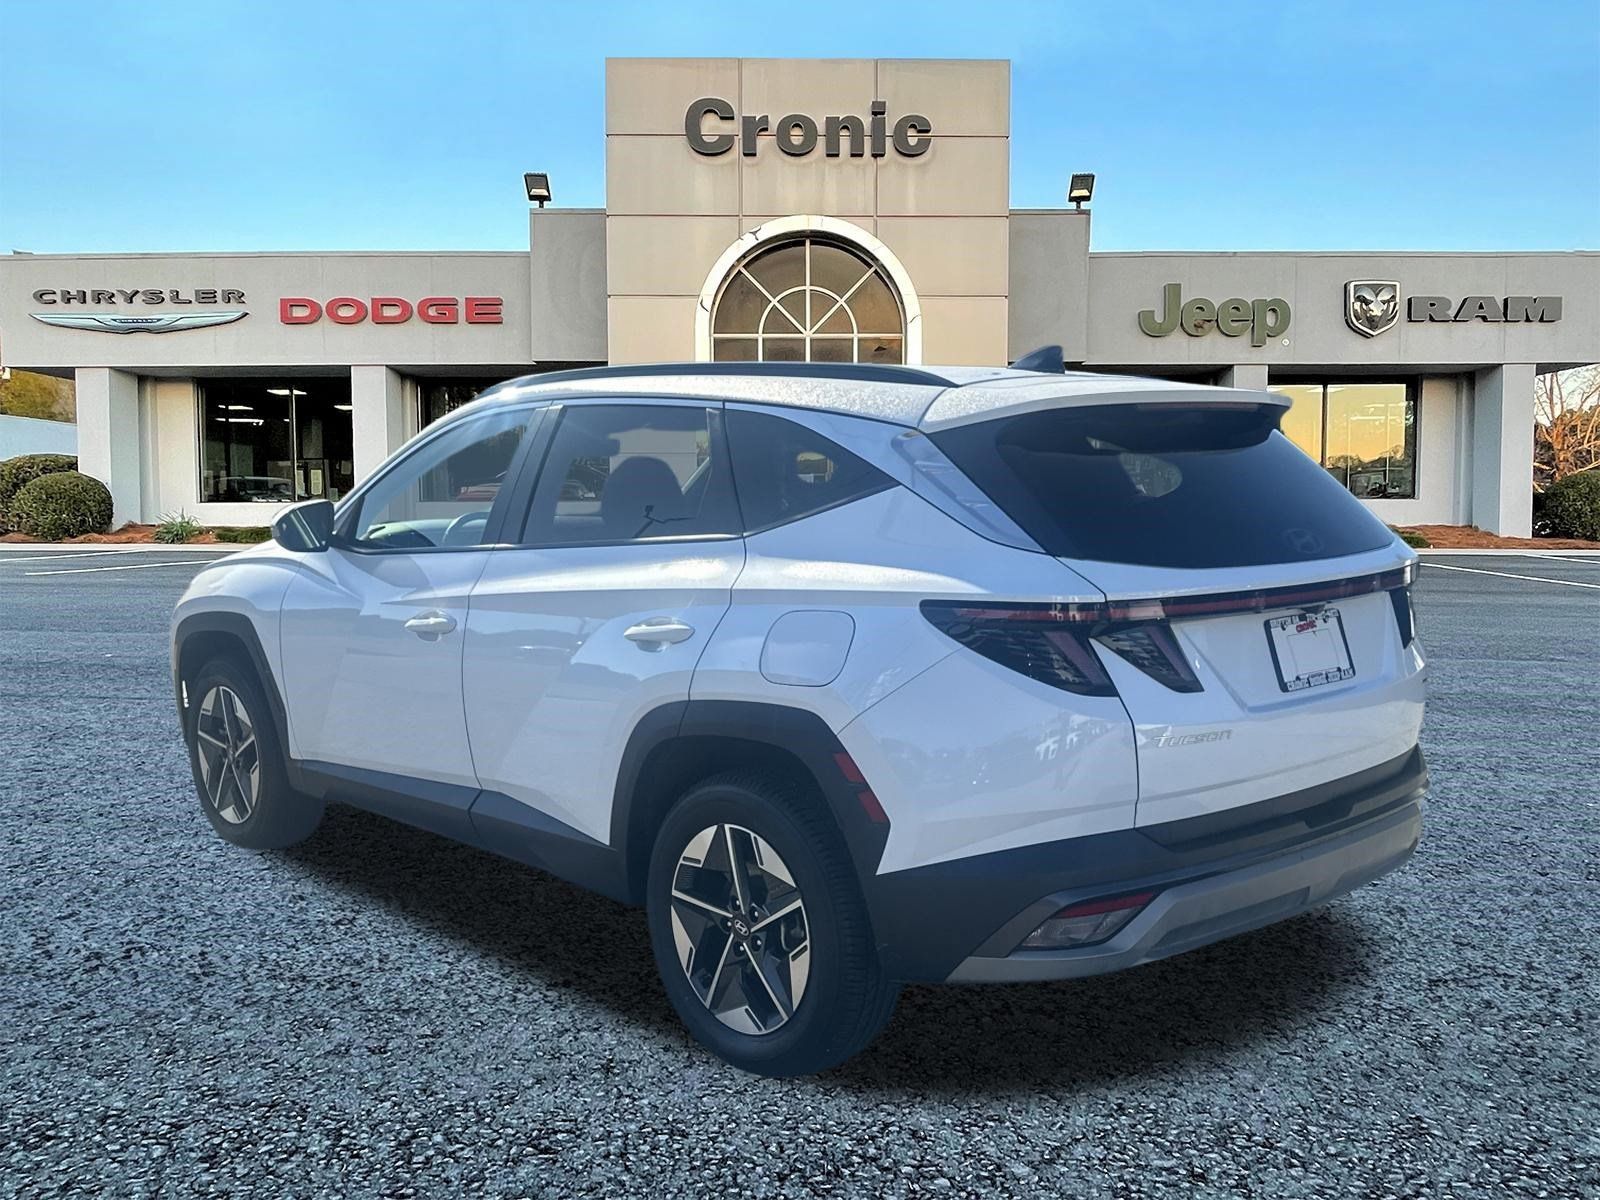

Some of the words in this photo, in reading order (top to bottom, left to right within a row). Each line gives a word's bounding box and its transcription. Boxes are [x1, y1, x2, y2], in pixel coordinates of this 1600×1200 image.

[685, 97, 932, 157] Cronic
[32, 288, 247, 305] CHRYSLER
[280, 296, 504, 326] DODGE
[1407, 296, 1563, 323] RAM
[1138, 283, 1292, 347] Jeep
